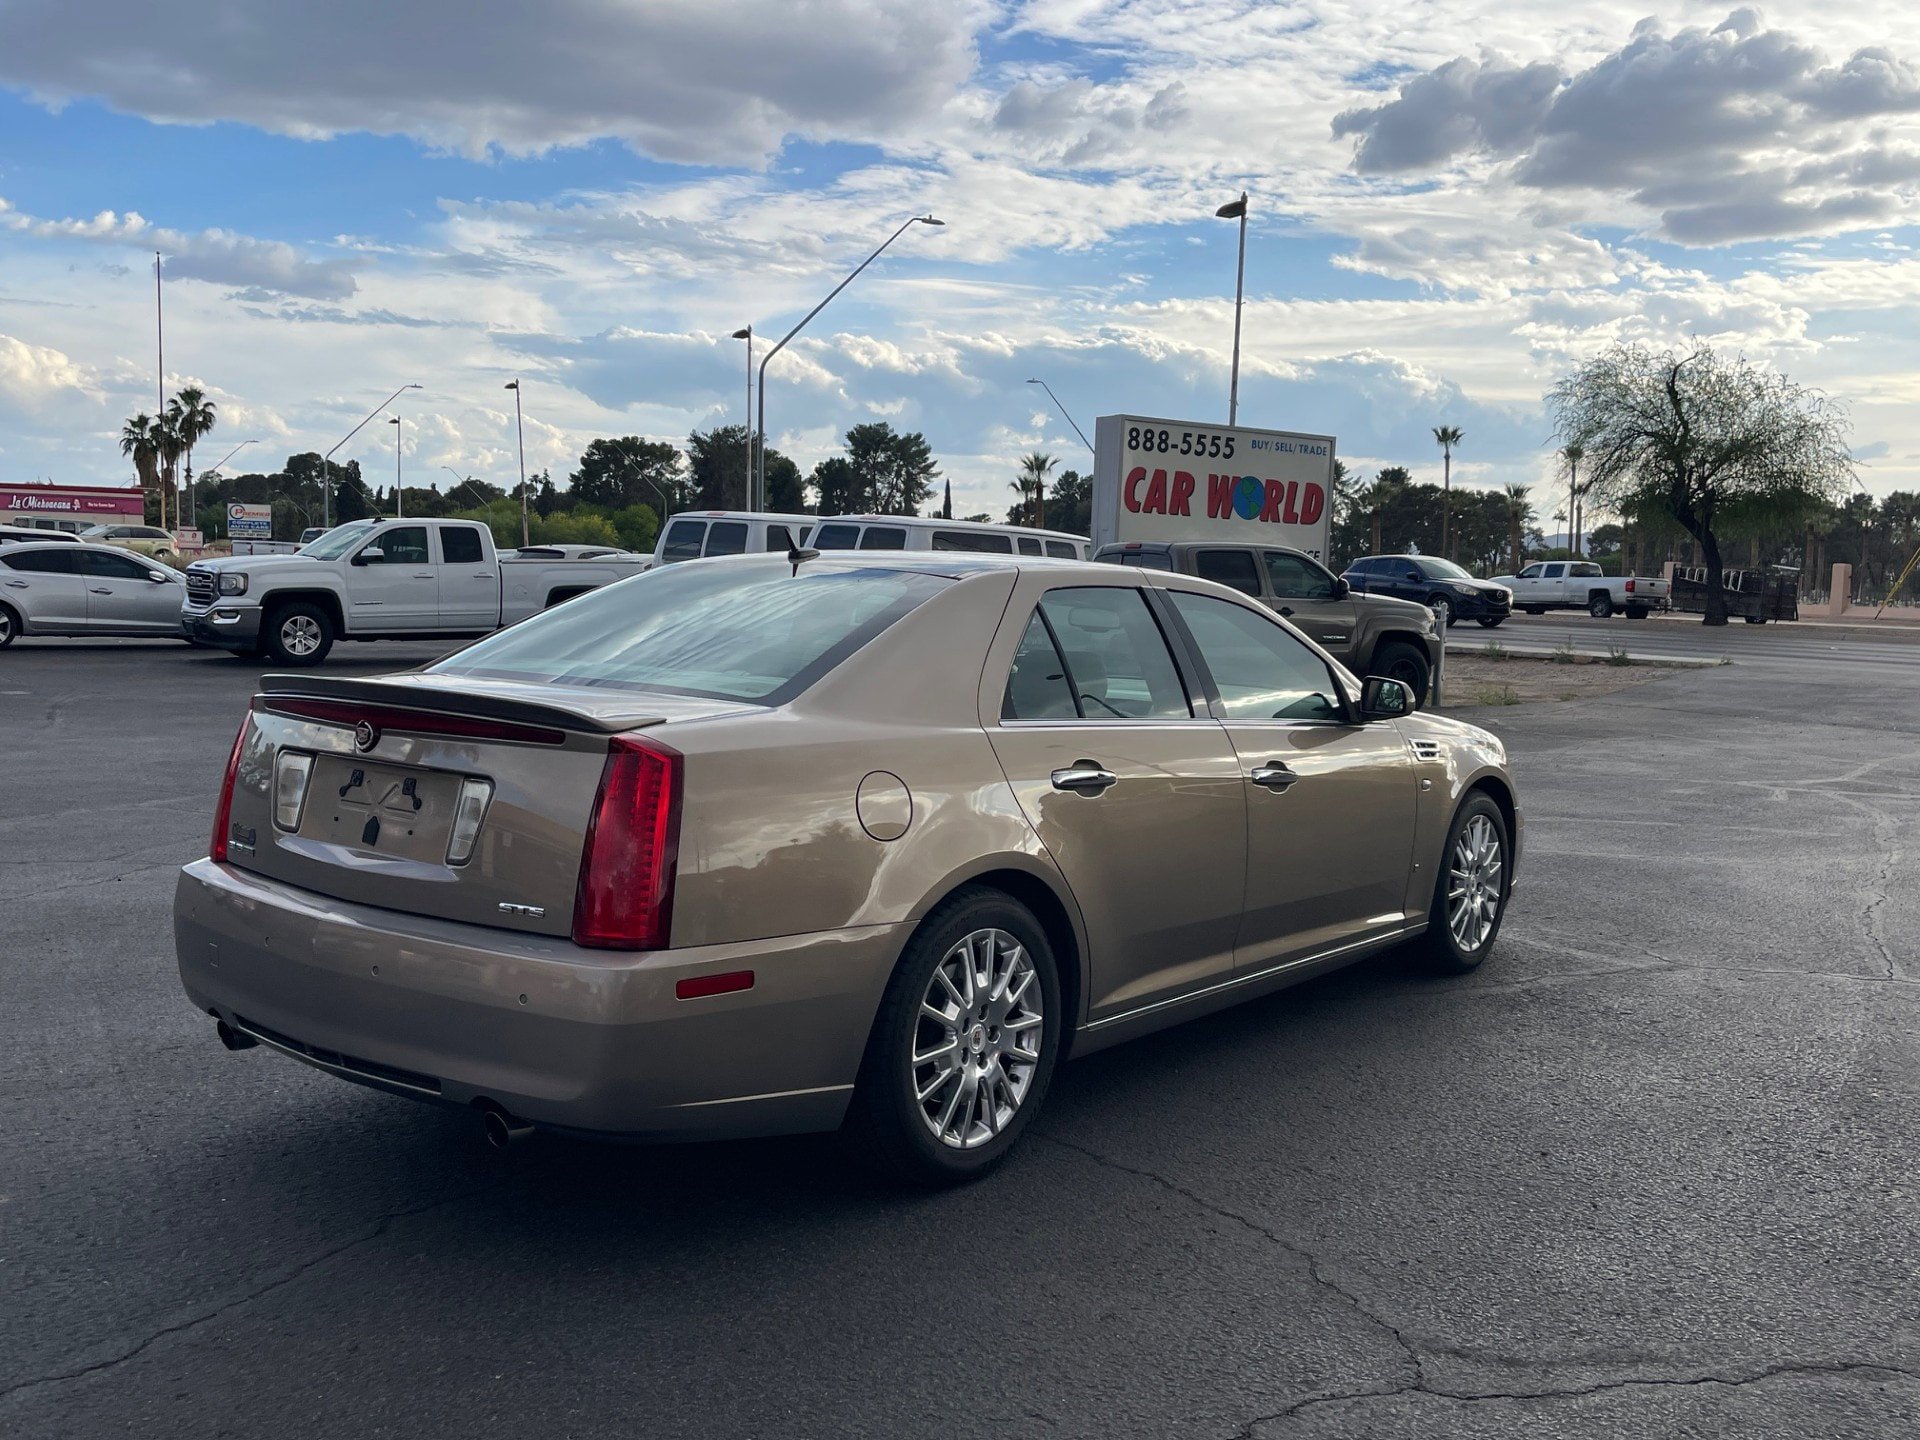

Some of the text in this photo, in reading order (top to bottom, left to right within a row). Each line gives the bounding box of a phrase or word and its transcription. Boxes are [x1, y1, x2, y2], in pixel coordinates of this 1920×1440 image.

[1127, 427, 1235, 459] 888-5555
[1299, 444, 1327, 456] TRADE
[8, 495, 20, 509] La
[1124, 466, 1324, 525] CAR WORLD
[499, 902, 545, 918] STS
